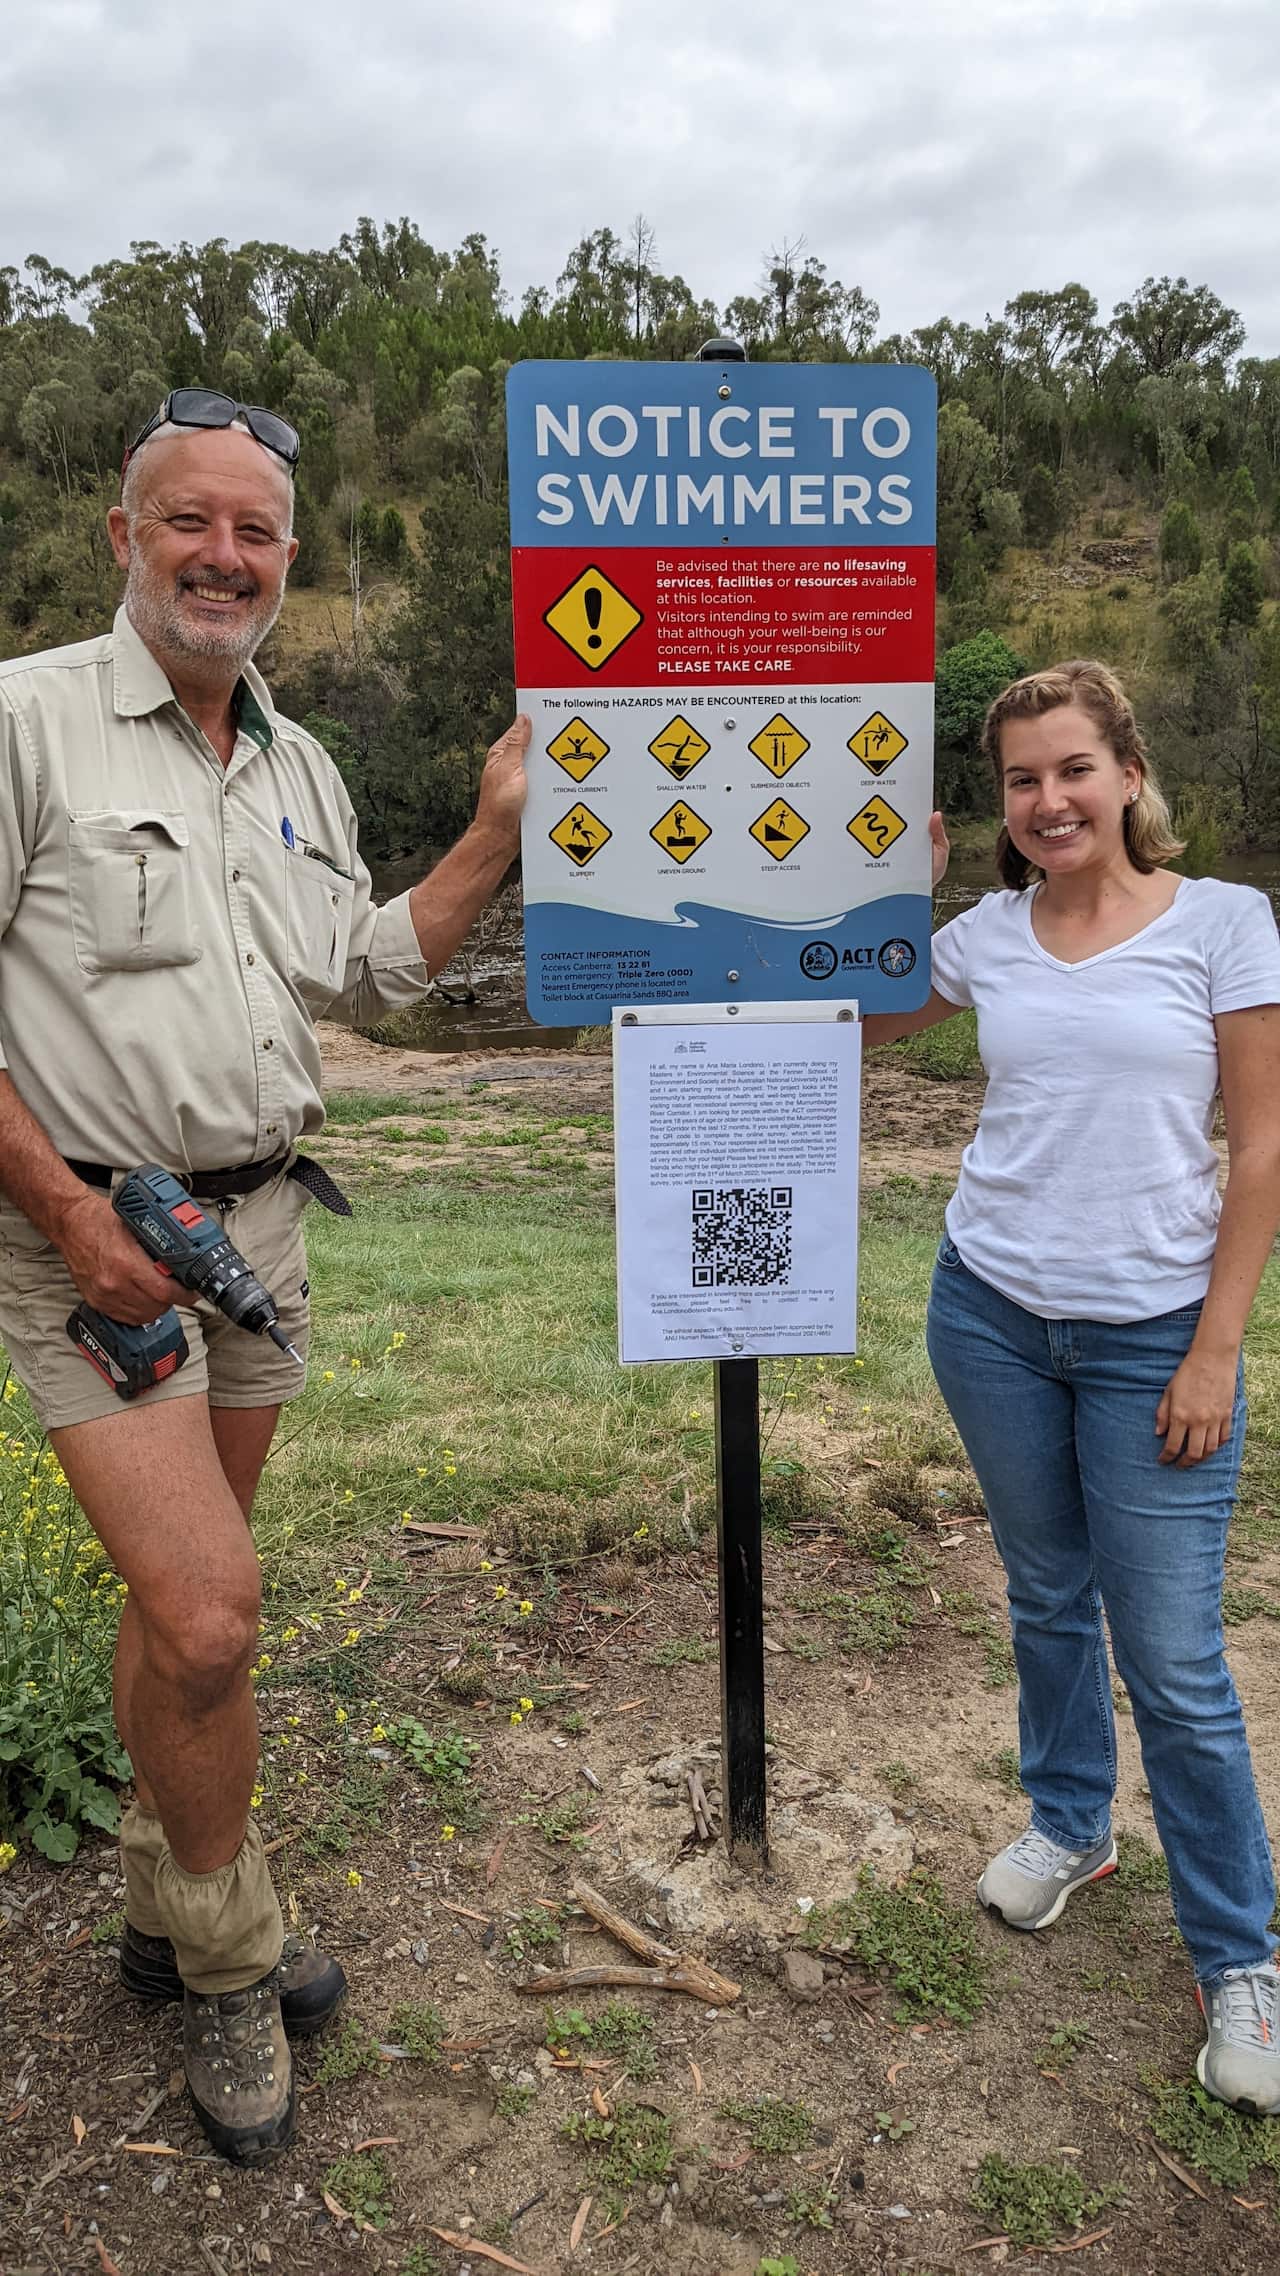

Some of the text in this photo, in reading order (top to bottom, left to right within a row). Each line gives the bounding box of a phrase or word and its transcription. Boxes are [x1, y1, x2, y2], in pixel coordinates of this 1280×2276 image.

[536, 404, 911, 459] NOTICE TO
[537, 473, 913, 525] SWIMMERS
[657, 559, 906, 573] Be advised that there are no lifesaving
[657, 575, 917, 589] services, facilities or resources available
[657, 592, 756, 604] at this location.
[657, 609, 912, 624] Visitors intending to swim are reminded
[657, 625, 887, 640] that although your well-being is our
[657, 642, 862, 656] concern, it is your responsibility.
[658, 661, 711, 673] PLEASE
[715, 660, 750, 672] TAKE
[542, 694, 861, 709] The following HAZARDS MAY BE ENCOUNTERED at this location:
[541, 950, 651, 961] CONTACT INFORMATION
[842, 948, 875, 964] ACT
[542, 964, 571, 972] Access
[628, 961, 640, 969] 22
[617, 971, 643, 980] Triple
[644, 970, 665, 978] Zero
[667, 969, 693, 978] (000)
[542, 983, 570, 992] Nearest
[572, 981, 614, 991] Emergency
[615, 981, 640, 990] phone
[641, 980, 647, 988] is
[648, 980, 676, 988] located
[542, 993, 562, 1002] Toilet
[564, 993, 585, 1001] block
[586, 993, 594, 1001] at
[594, 992, 631, 1000] Casuarina
[632, 991, 655, 999] Sands
[656, 991, 673, 999] BBQ
